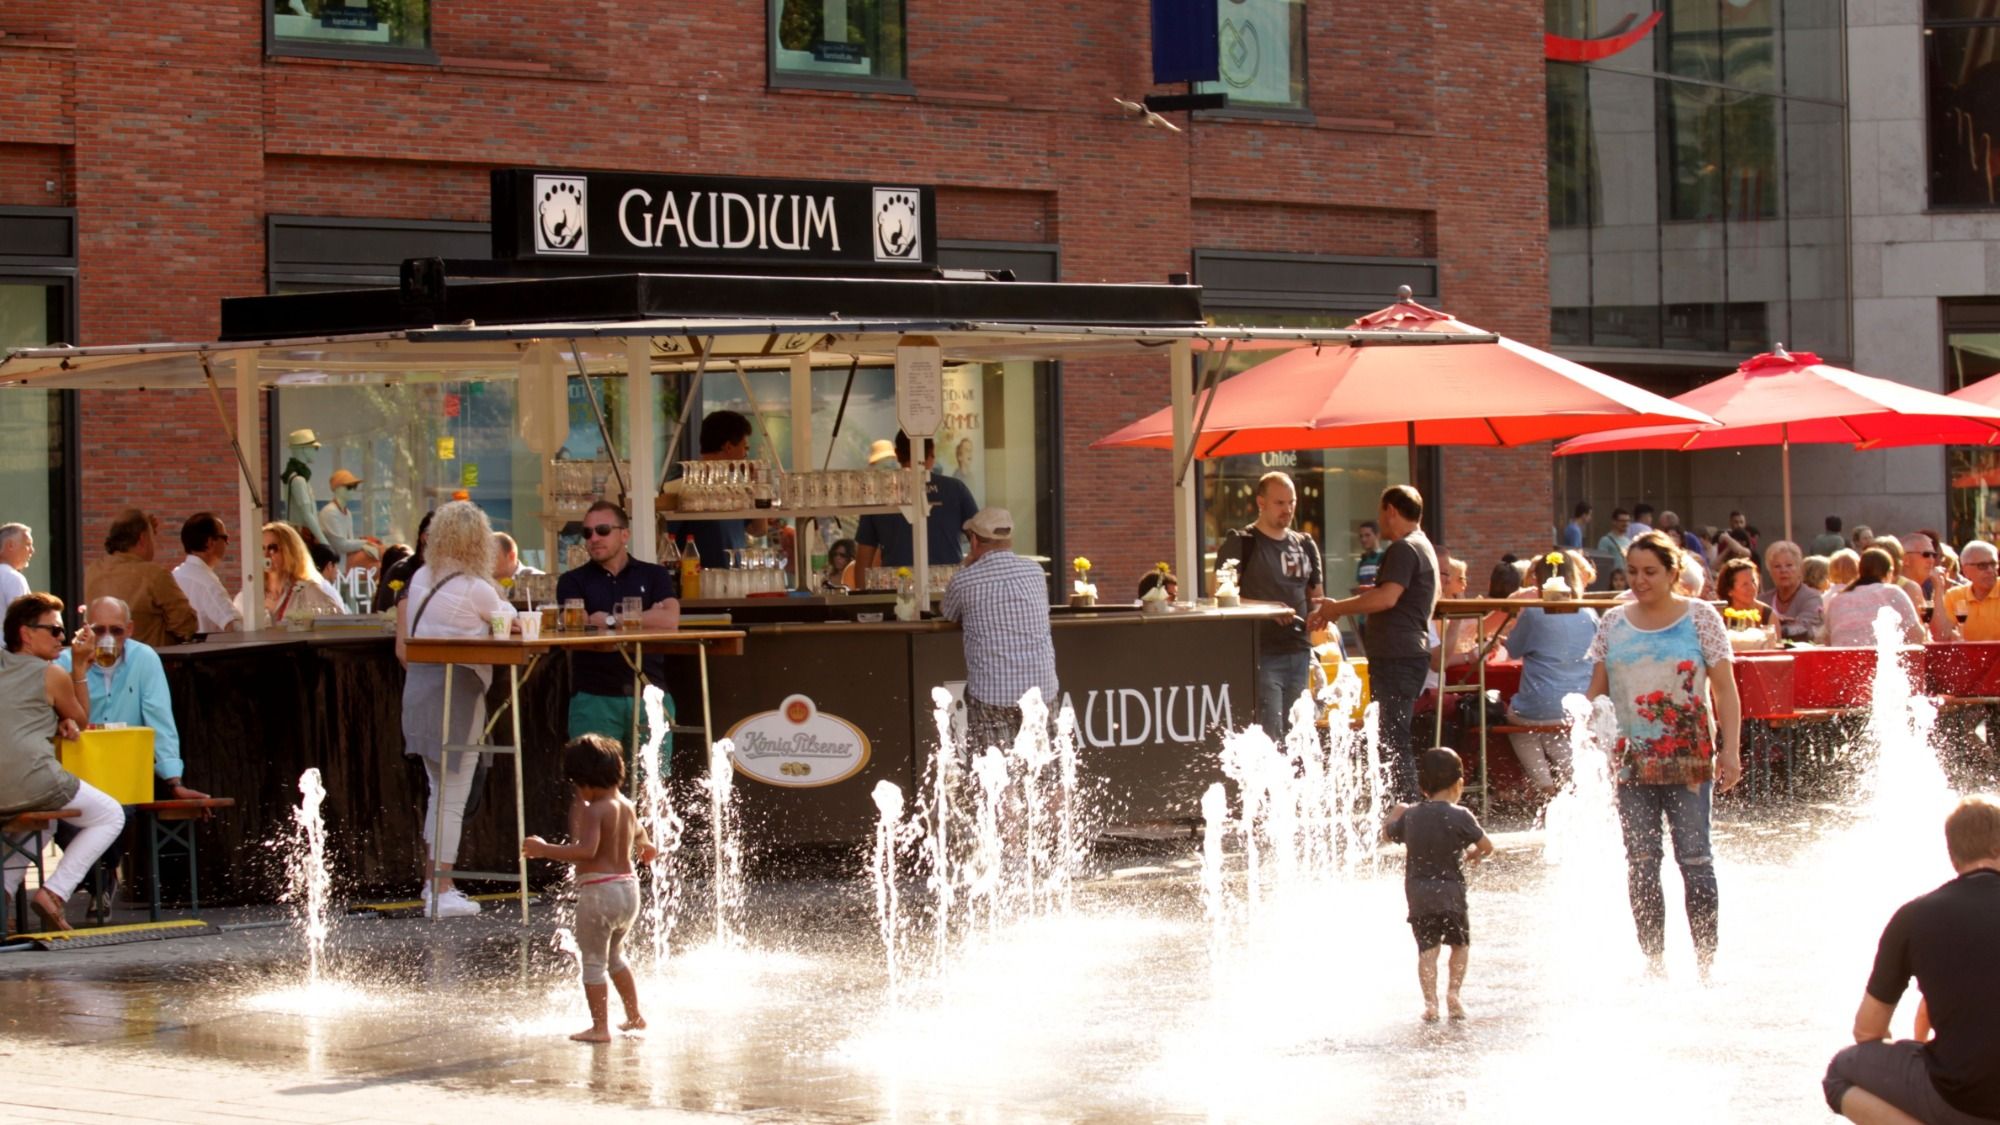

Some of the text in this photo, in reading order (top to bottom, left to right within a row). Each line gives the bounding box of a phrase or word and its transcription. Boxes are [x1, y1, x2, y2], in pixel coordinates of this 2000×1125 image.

[618, 188, 841, 252] GAUDIUM
[1261, 449, 1297, 468] Chloé
[1057, 683, 1235, 750] AUDIUM
[742, 731, 853, 757] König Pilsener
